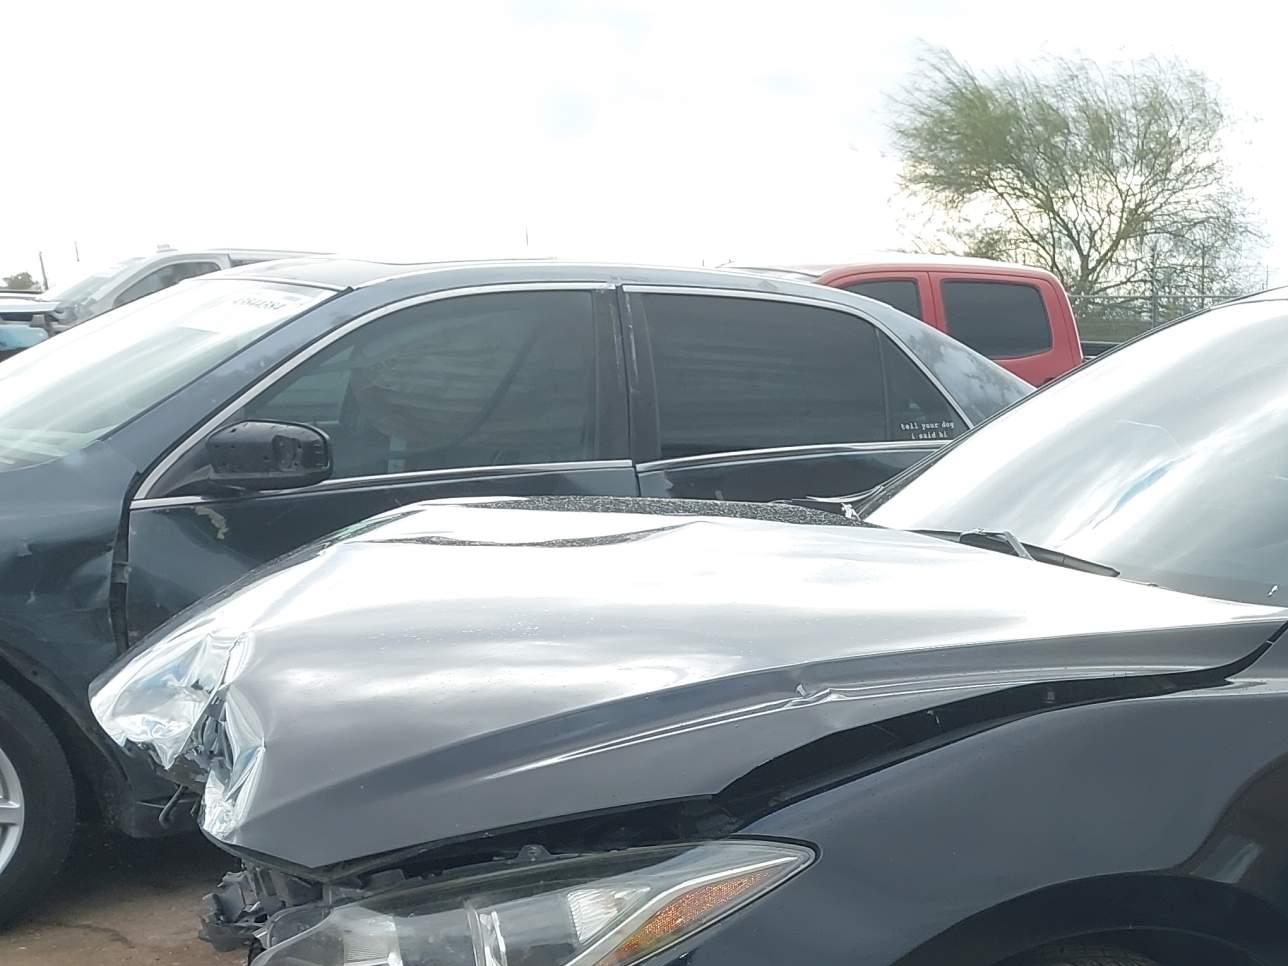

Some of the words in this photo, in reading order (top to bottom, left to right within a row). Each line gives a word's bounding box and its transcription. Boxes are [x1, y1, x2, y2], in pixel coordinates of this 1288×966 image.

[900, 422, 918, 430] tell
[941, 420, 954, 429] dog
[918, 431, 936, 439] said
[938, 430, 948, 438] hi
